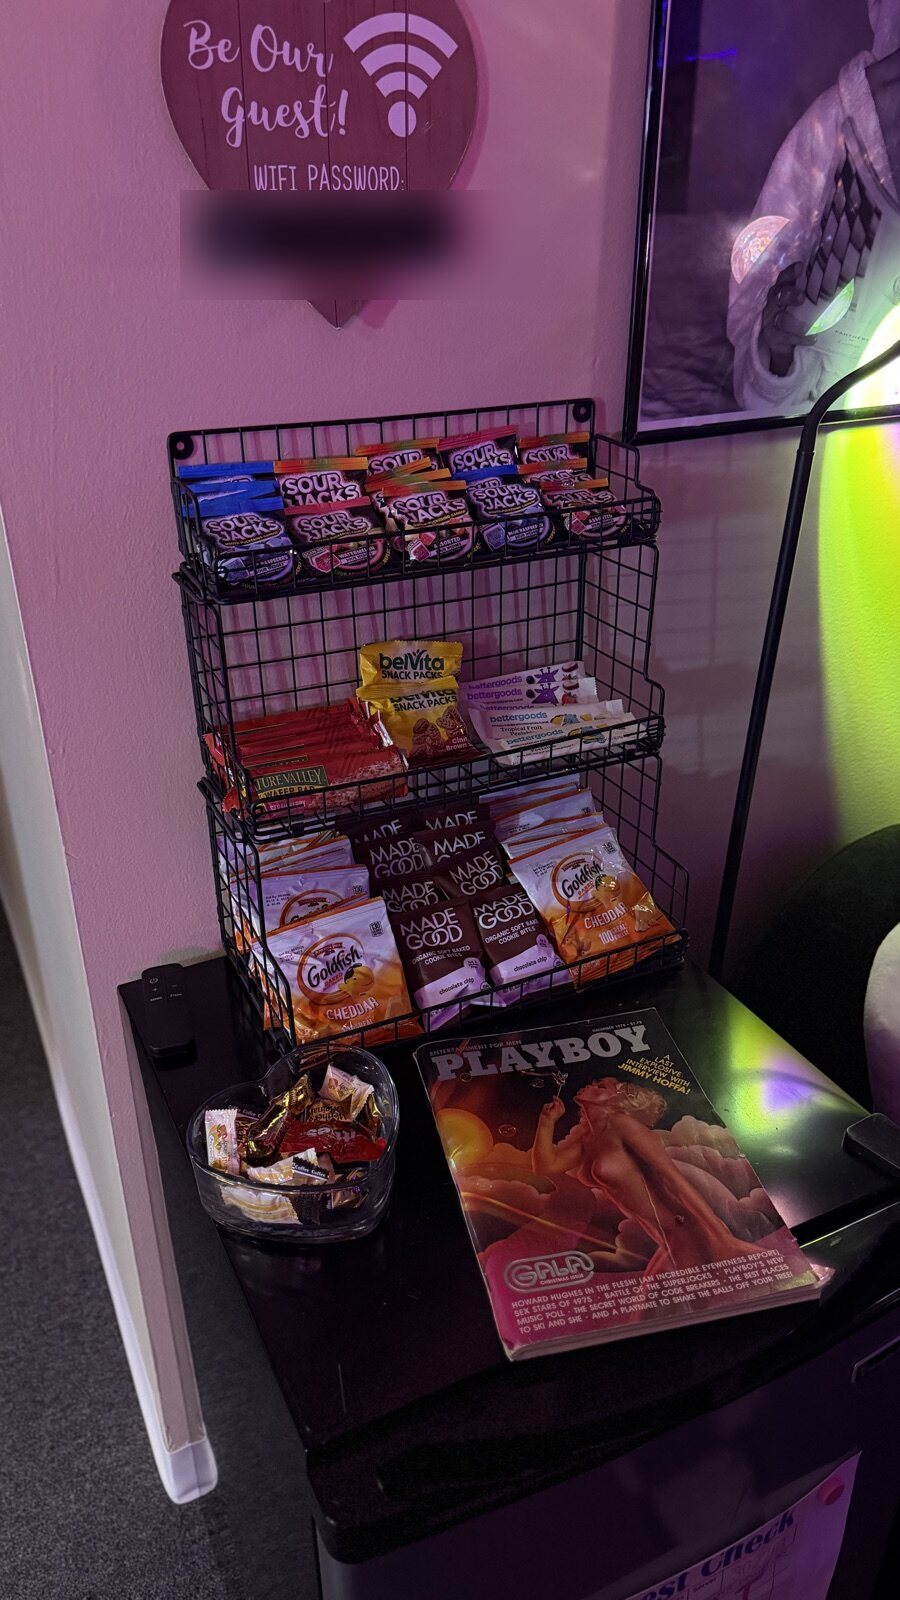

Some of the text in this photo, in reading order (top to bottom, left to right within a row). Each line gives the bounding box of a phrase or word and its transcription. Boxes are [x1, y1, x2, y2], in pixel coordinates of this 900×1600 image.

[183, 20, 333, 77] Be Our
[221, 84, 349, 148] Guest!
[254, 163, 405, 190] WIFI PASSWORD:
[453, 443, 498, 470] SOUR
[527, 446, 569, 464] SOUR
[283, 473, 344, 495] SOUR
[474, 484, 521, 500] SOUR
[394, 493, 446, 514] SOUR
[408, 499, 468, 523] JACKS
[485, 490, 537, 511] JACKS
[208, 514, 261, 532] SOUR
[299, 512, 349, 531] SOUR
[310, 518, 367, 540] JACKS
[588, 513, 613, 524] ASSOTED
[219, 520, 279, 542] JACKS
[433, 536, 461, 550] ASORTED
[379, 649, 444, 671] belVita
[381, 670, 443, 680] SNACK PACKS
[393, 695, 458, 712] SNACK PACKS
[467, 687, 523, 700] bettergoods
[489, 711, 548, 723] bettergoods
[499, 725, 526, 733] Tropical
[506, 729, 564, 745] bettergoods
[446, 743, 468, 751] Brown
[254, 767, 323, 791] TURE VALLEY
[369, 837, 420, 865] MADE
[374, 853, 425, 879] GOOD
[449, 850, 499, 884] MADE
[460, 864, 504, 896] GOOD
[561, 860, 604, 898] Goldfish
[382, 880, 434, 903] MADE
[474, 892, 529, 916] MADE
[478, 901, 534, 929] GOOD
[584, 901, 629, 929] CHEDDAR
[400, 906, 455, 937] MADE
[484, 928, 510, 943] ORGANIC
[510, 922, 525, 933] SOFT
[406, 924, 463, 950] GOOD
[498, 925, 536, 945] COOKIE BITES
[412, 949, 437, 965] ORGANIC
[451, 945, 471, 953] BAKED
[424, 954, 446, 965] COOKIE
[513, 955, 548, 972] chocolate chip
[307, 945, 361, 988] Goldfish
[439, 977, 475, 995] chocolate chip
[326, 996, 380, 1020] CHEDDAR
[431, 1024, 651, 1082] PLAYBOY
[654, 1056, 674, 1068] LAST
[626, 1058, 690, 1087] INTERVIEW WITH
[639, 1057, 682, 1077] EXPLOSIVE
[617, 1063, 691, 1095] JIMMY HOFFA!
[294, 1164, 326, 1178] Coffee Coffee
[510, 1254, 590, 1288] GALA
[511, 1295, 549, 1309] HOWARD
[550, 1288, 583, 1301] HUGHES
[596, 1284, 610, 1293] THE
[612, 1278, 637, 1289] FLESH!
[639, 1274, 654, 1284] (AN
[656, 1265, 701, 1281] INCREDIBLE
[701, 1255, 747, 1272] EYEWITNESS
[513, 1255, 784, 1317] SEX STARS OF 1975 BATTLE OF THE SUPERJOCKS PLAYBOY'S NEW
[516, 1263, 790, 1327] MUSIC POLL THE SECRET WORLD OF CODE BREAKERS THE BEST PLACES
[519, 1271, 794, 1335] TO SKI AND SHE AND A PLAYMATE TO SHAKE THE BALLS OFF YOUR TREE!
